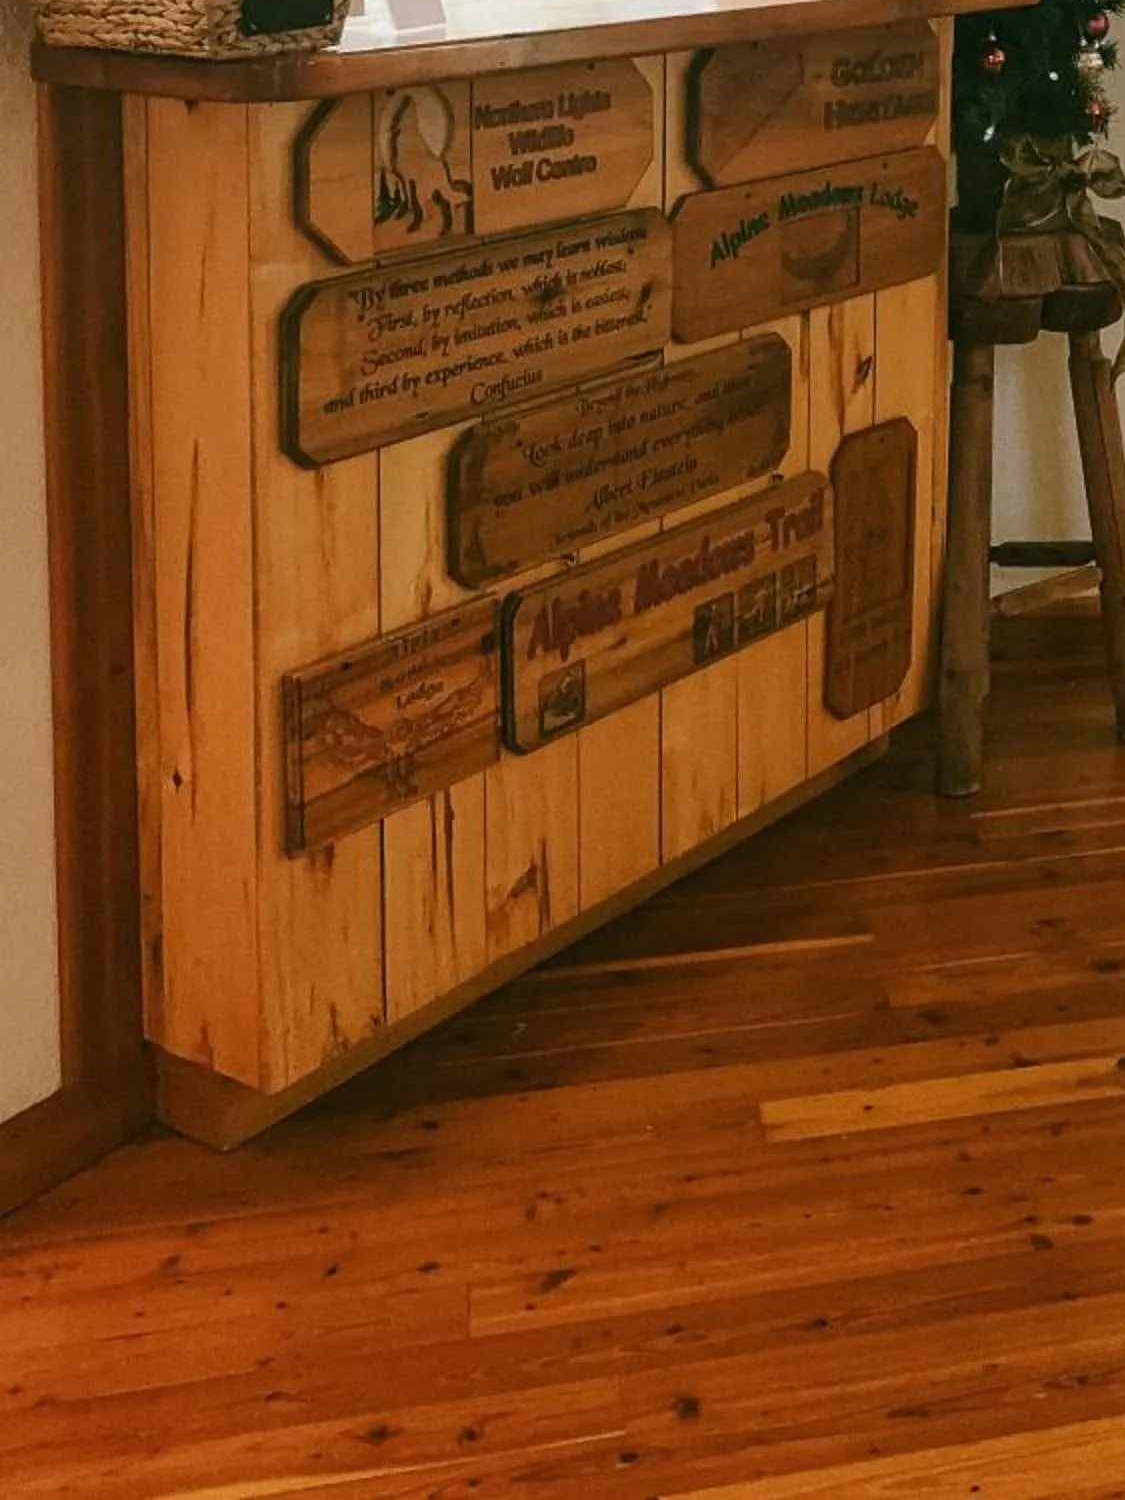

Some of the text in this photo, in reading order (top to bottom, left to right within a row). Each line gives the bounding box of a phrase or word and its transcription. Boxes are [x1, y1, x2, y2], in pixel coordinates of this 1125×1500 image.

[491, 160, 534, 190] Wolf
[709, 212, 770, 270] Alpine
[870, 181, 919, 220] Lodge
[496, 257, 518, 272] we
[523, 249, 553, 269] may
[422, 304, 440, 327] by
[521, 271, 562, 296] which
[431, 334, 450, 357] by
[526, 301, 566, 323] which
[571, 297, 582, 314] is
[321, 388, 355, 414] and
[358, 375, 397, 405] third
[402, 370, 421, 397] by
[512, 332, 553, 359] which
[557, 328, 569, 346] is
[572, 324, 591, 342] the
[470, 367, 544, 405] Confucius
[567, 427, 603, 449] deep
[608, 414, 637, 436] into
[528, 469, 559, 495] will
[564, 437, 647, 484] understand
[585, 481, 632, 511] Albert
[635, 458, 697, 491] Einstein
[527, 587, 622, 662] Alpine
[633, 530, 755, 613] Meadows
[765, 487, 824, 551] Trail
